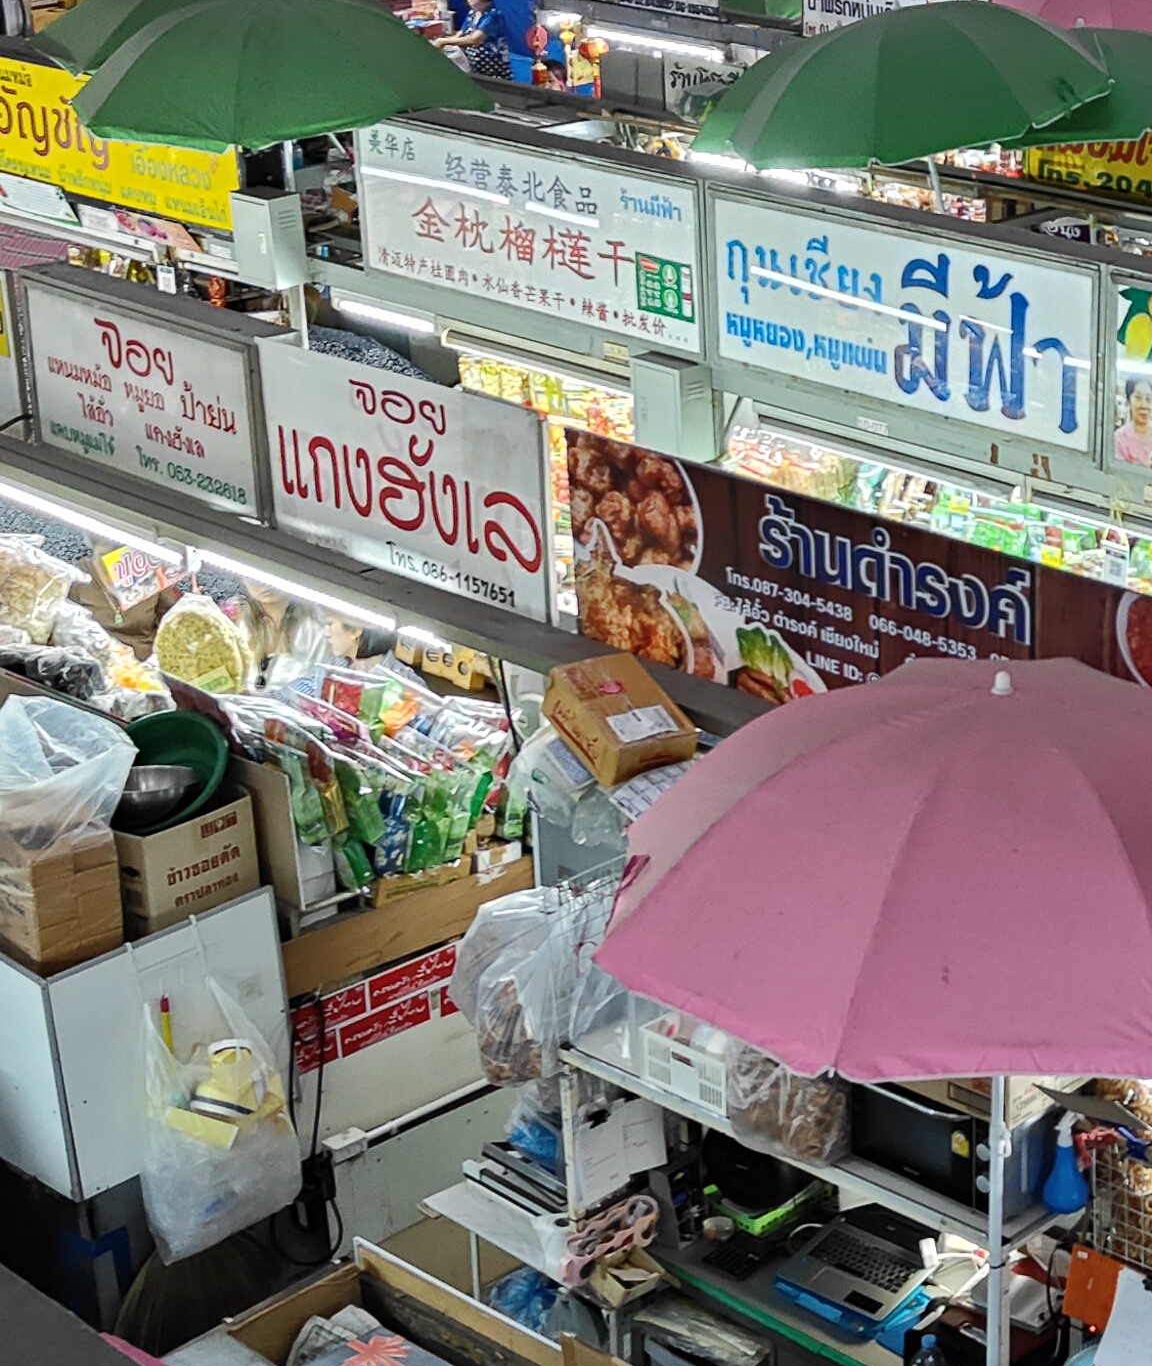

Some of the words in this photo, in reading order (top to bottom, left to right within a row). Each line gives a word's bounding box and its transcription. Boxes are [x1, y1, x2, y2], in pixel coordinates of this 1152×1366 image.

[367, 130, 416, 161] 美华店
[444, 152, 598, 215] 经营泰北食品
[619, 187, 683, 222] ร้านมีฟ้า
[94, 317, 174, 386] จอย
[895, 253, 1078, 434] มีฟ้า
[180, 380, 237, 435] ป้าย่น
[349, 378, 446, 436] จอย
[278, 423, 543, 574] แกงฮังเล
[421, 559, 517, 608] 086-1157651
[759, 494, 1032, 645] ร้านดำรงค์
[806, 650, 840, 674] LINE
